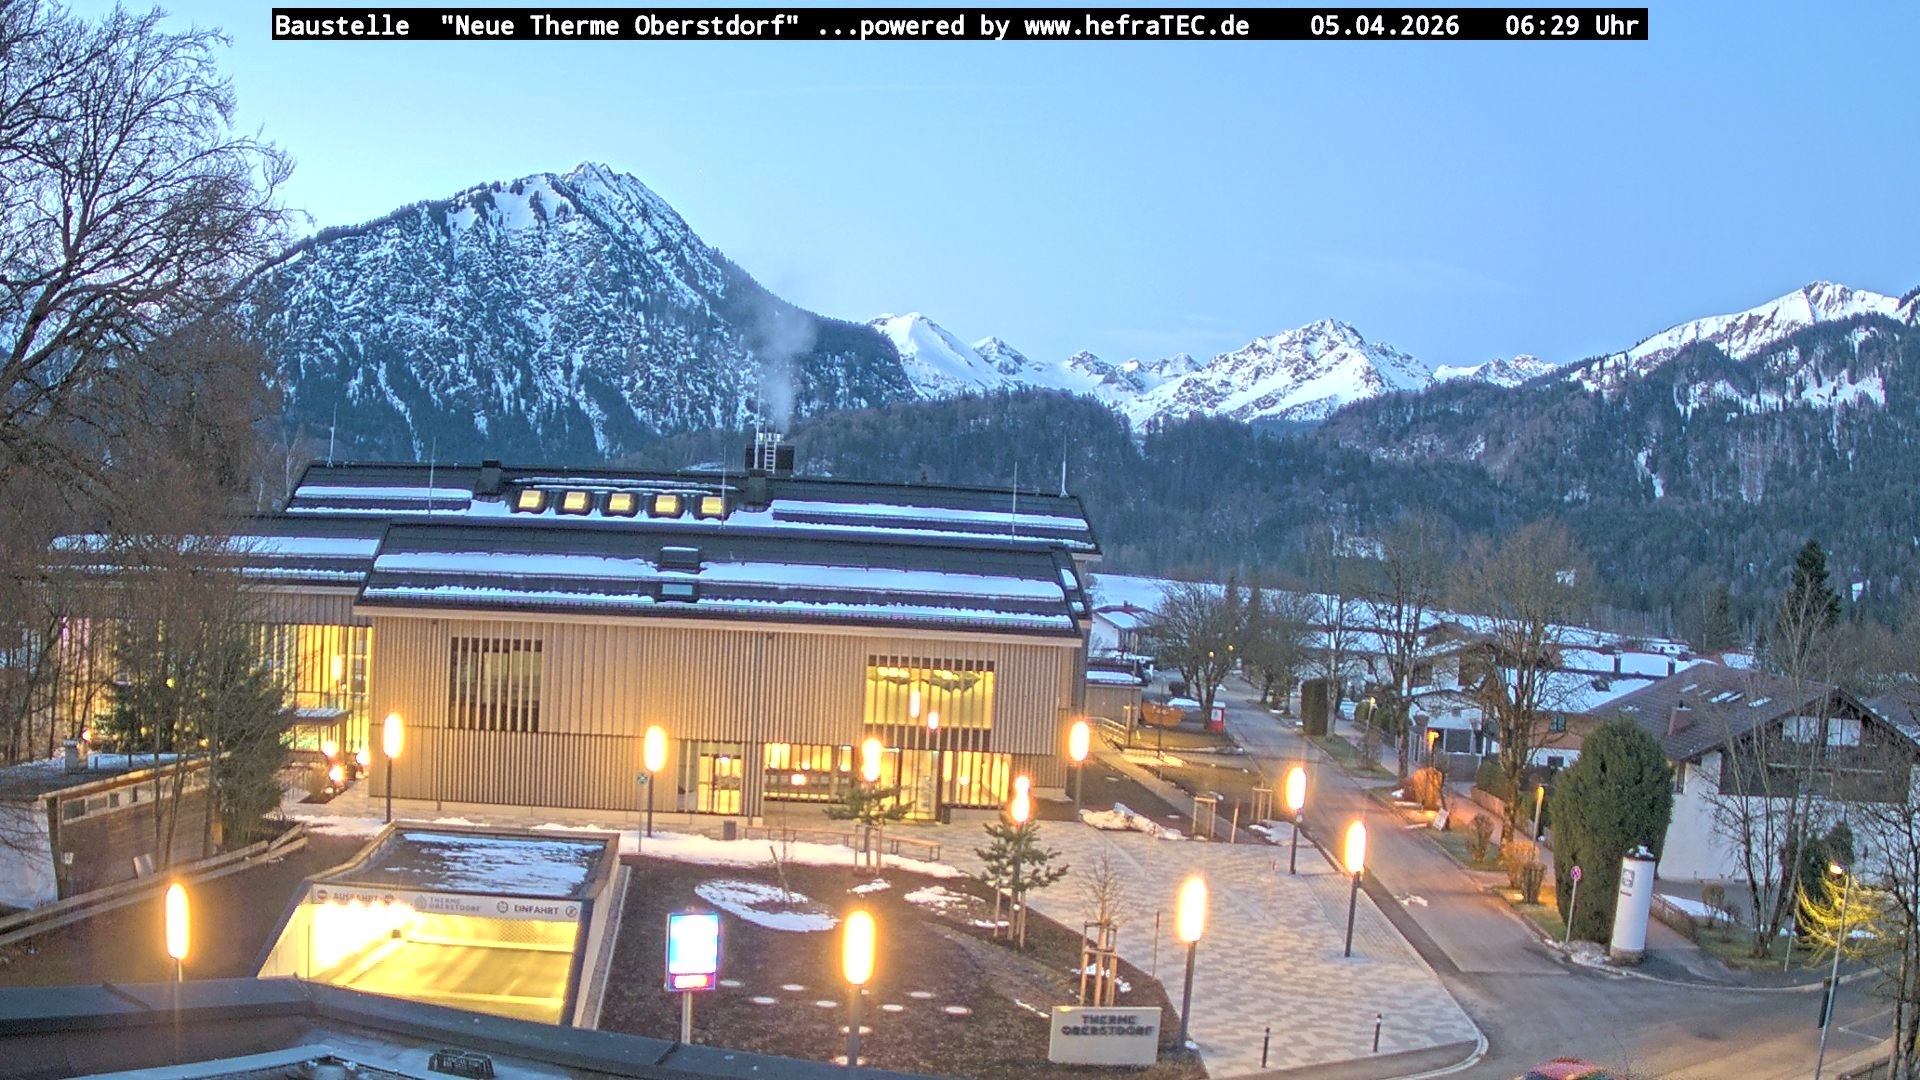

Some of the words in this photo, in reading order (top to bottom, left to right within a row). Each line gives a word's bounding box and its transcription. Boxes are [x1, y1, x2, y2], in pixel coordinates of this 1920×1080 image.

[514, 904, 559, 915] EINFAHRT
[1081, 1014, 1137, 1024] THERME
[1062, 1025, 1154, 1035] OBERSTDORF
